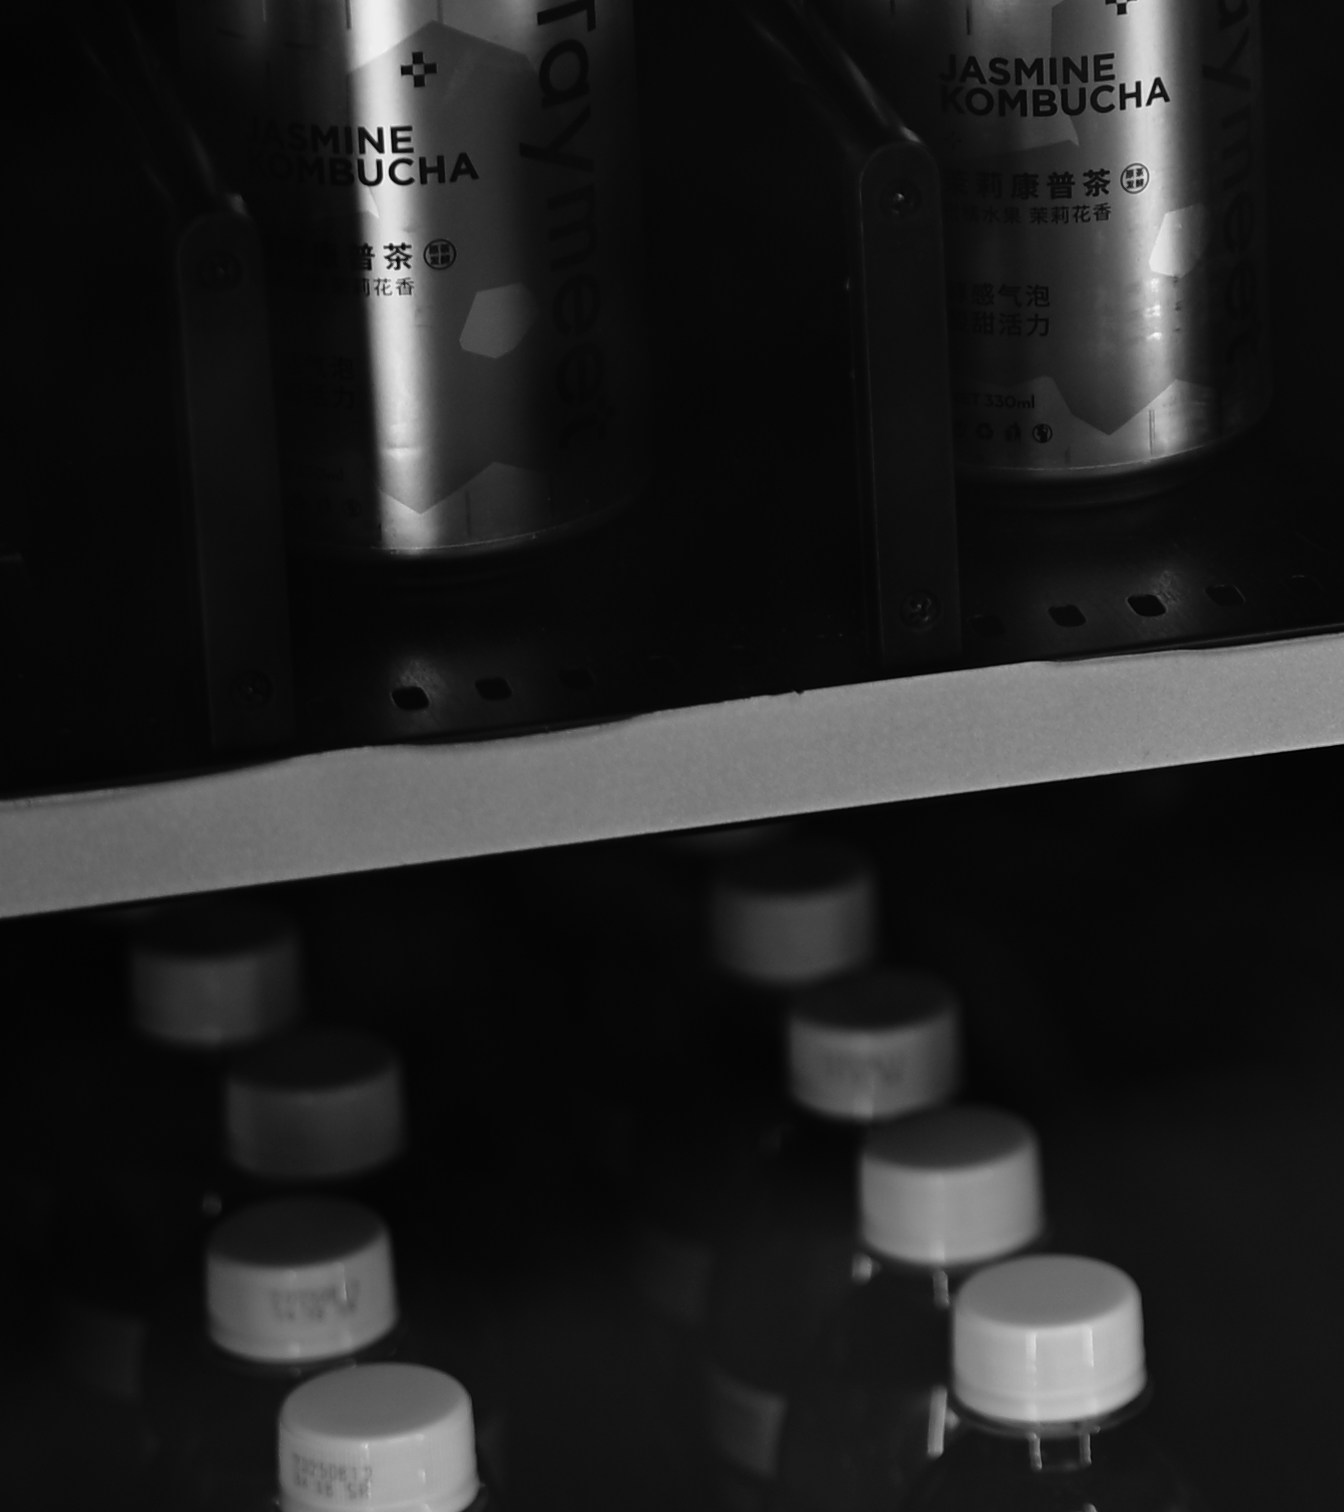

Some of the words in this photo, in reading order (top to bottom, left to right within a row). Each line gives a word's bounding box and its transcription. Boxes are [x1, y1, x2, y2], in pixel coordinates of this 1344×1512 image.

[940, 52, 1116, 86] JASMINE
[941, 76, 1171, 118] KOMBUCHA
[984, 393, 1035, 409] 330ml
